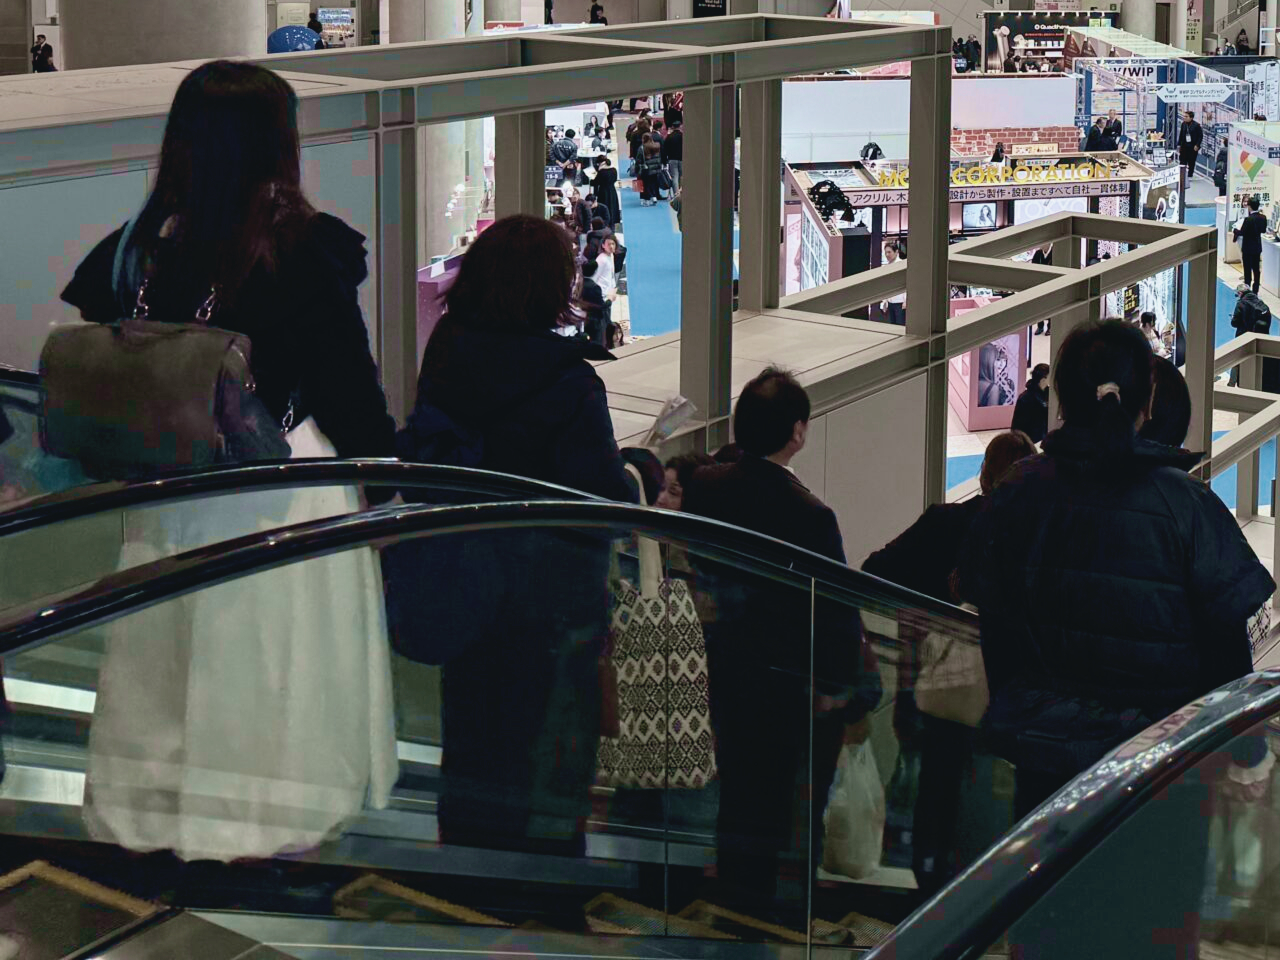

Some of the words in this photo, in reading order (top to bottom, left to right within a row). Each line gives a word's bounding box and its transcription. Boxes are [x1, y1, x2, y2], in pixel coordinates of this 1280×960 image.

[952, 162, 1111, 186] CORPORATION
[854, 192, 909, 204] アクリル、木
[950, 181, 1129, 200] 設計から製作・設置まですべて自社一貫体制
